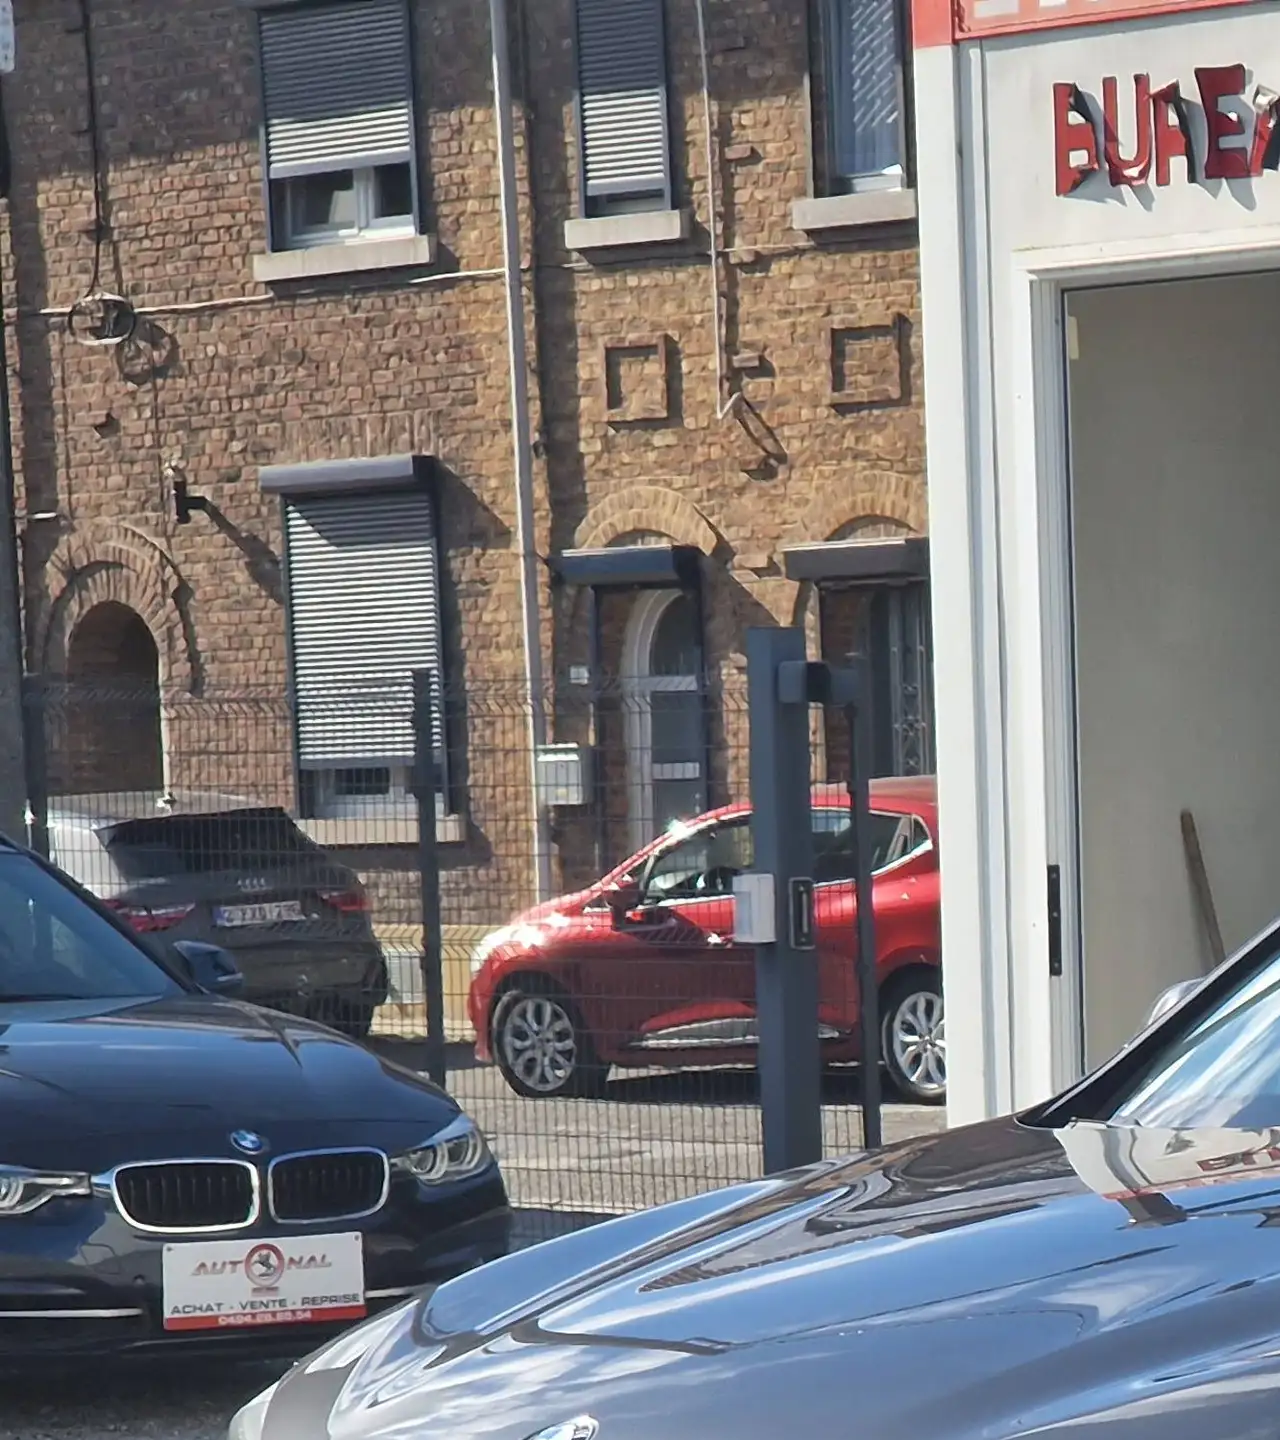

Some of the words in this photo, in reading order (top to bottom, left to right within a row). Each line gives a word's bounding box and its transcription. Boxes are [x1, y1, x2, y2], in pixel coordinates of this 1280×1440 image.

[170, 1302, 225, 1315] ACHAT
[239, 1298, 287, 1310] VENTE
[301, 1293, 360, 1306] REPRISE
